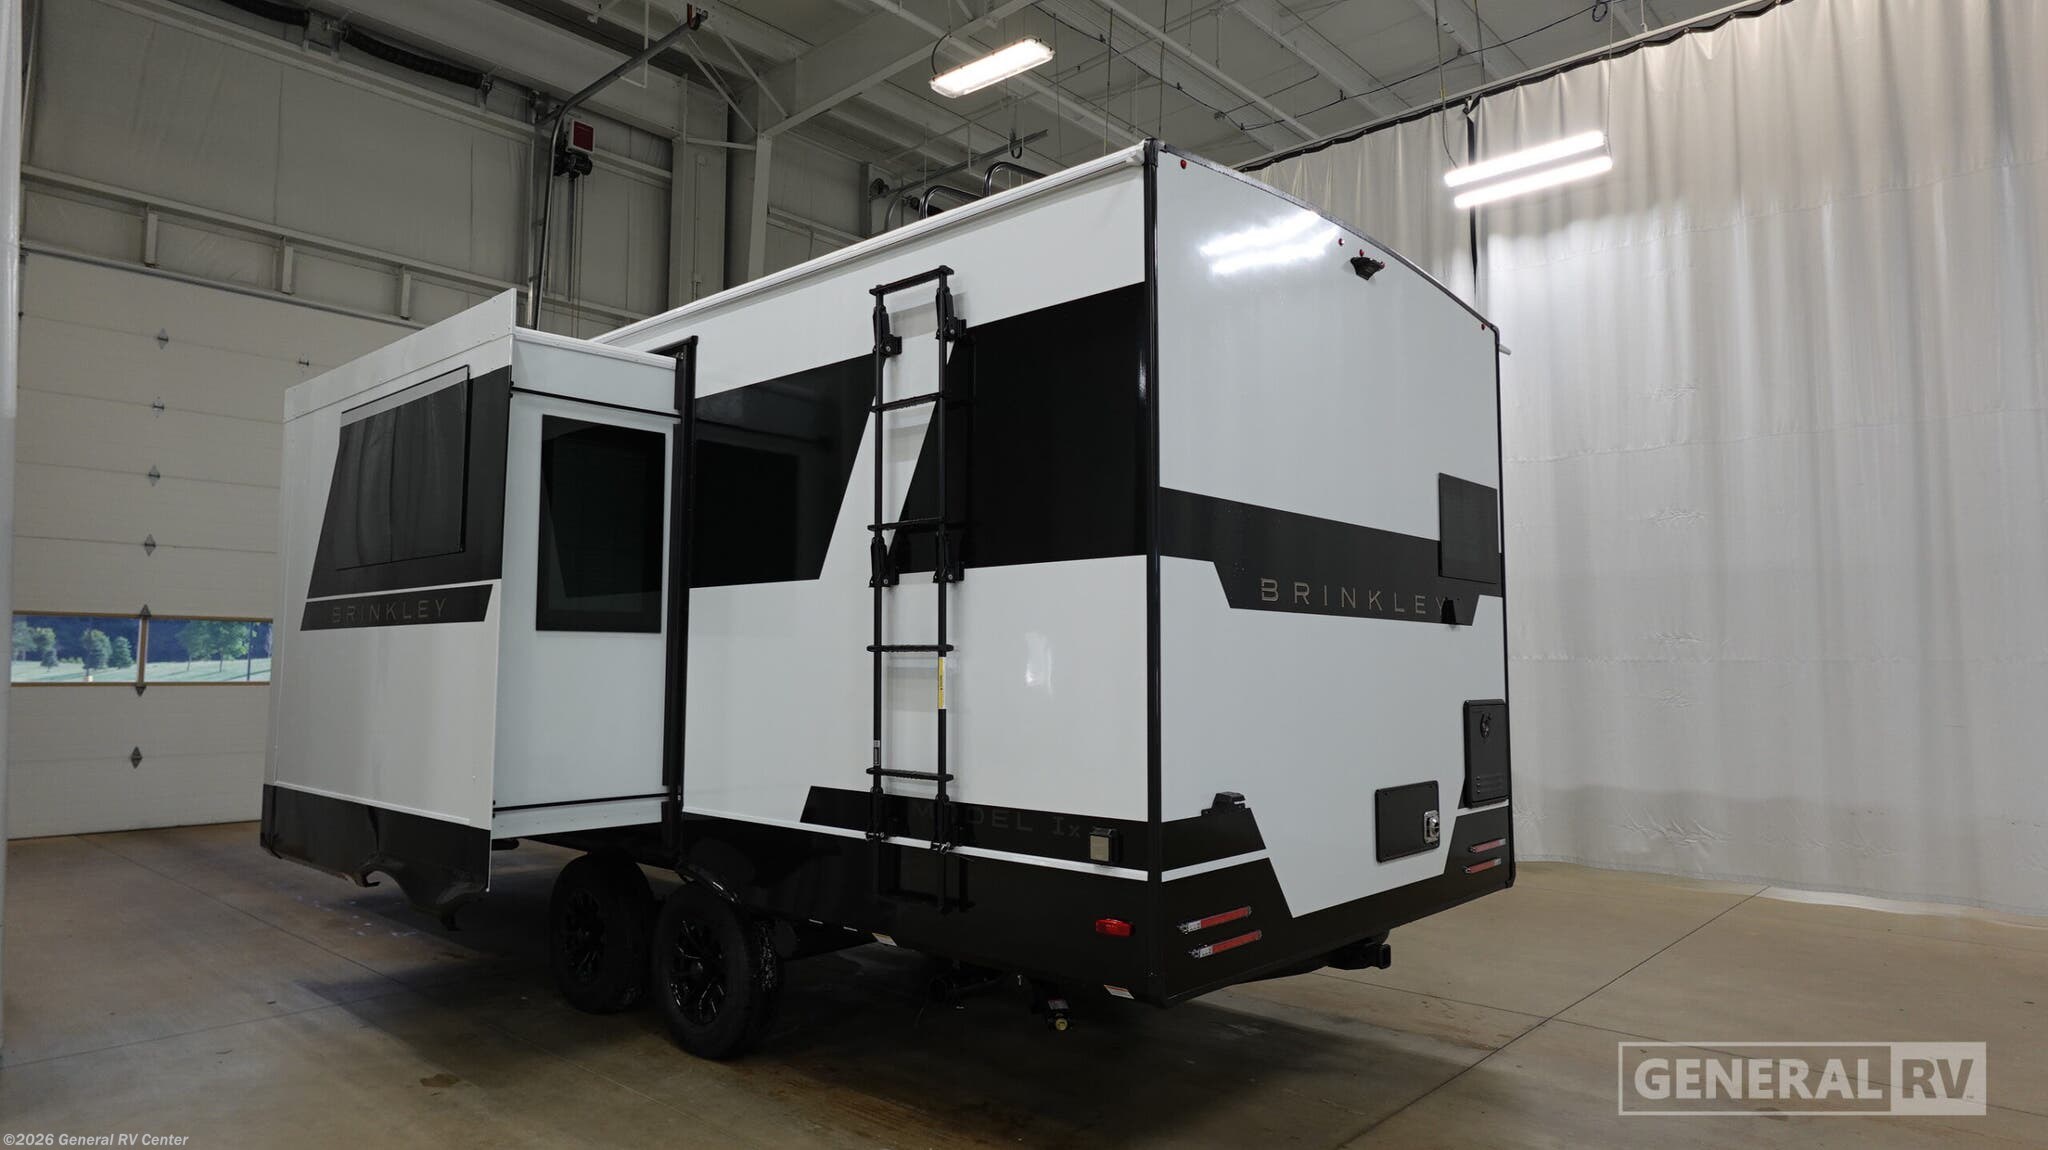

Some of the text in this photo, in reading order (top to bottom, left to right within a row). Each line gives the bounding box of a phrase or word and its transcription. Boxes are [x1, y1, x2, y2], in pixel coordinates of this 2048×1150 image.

[332, 598, 447, 624] BRINKLEY
[1260, 578, 1448, 615] BRINKLEY
[911, 801, 1033, 832] MDEL
